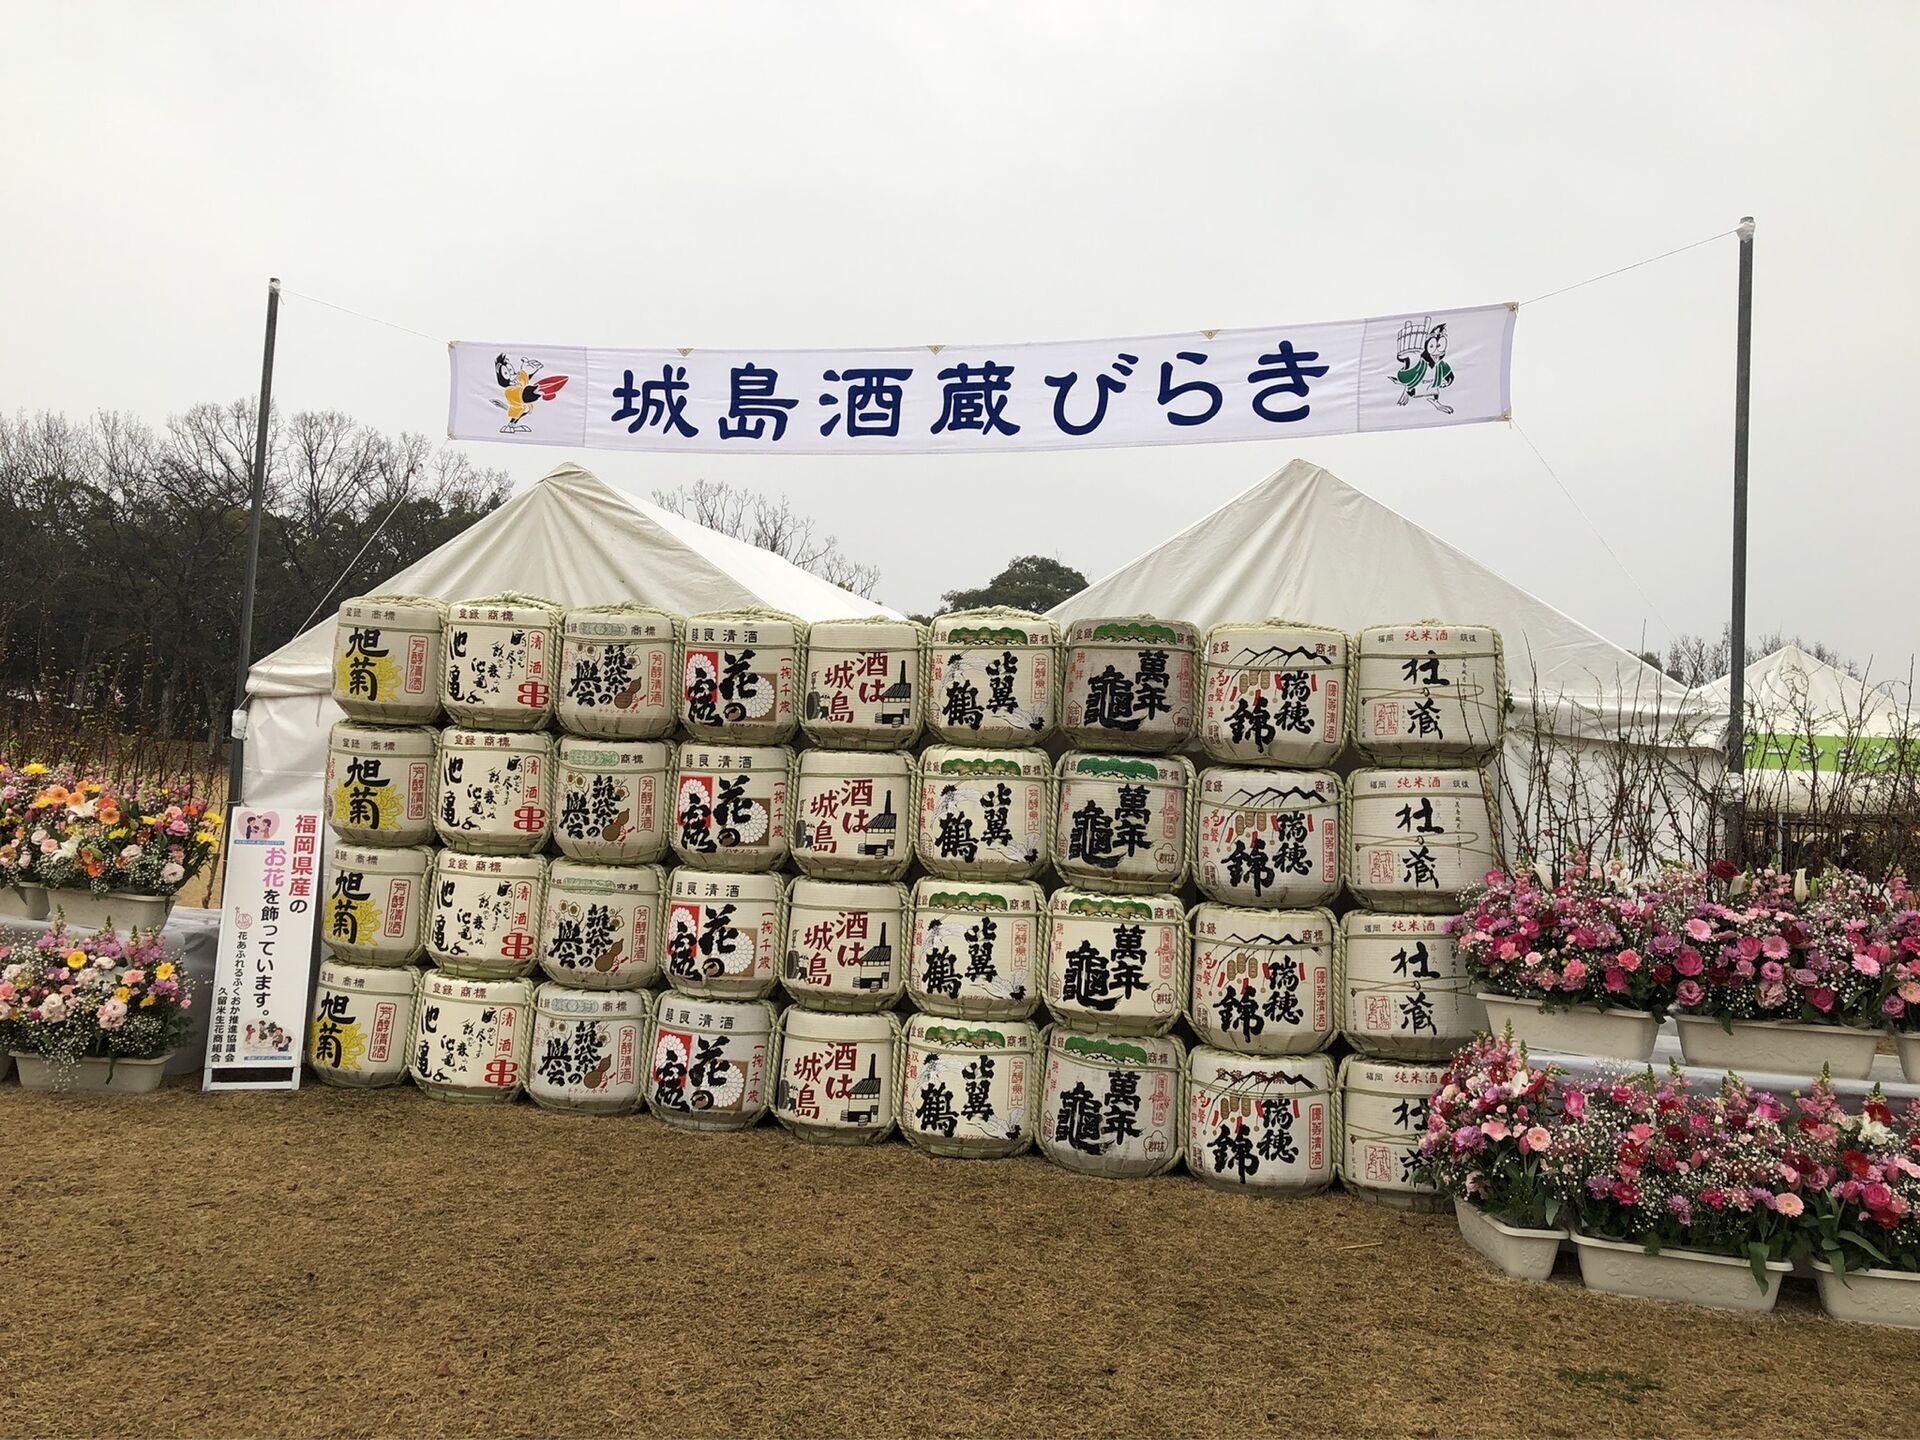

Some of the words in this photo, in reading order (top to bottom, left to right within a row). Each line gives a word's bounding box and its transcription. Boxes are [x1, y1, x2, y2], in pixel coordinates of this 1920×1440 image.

[610, 340, 1332, 442] 城島酒蔵びらき
[371, 610, 395, 621] 商標
[458, 608, 479, 620] 登録
[488, 610, 514, 621] 商標
[631, 625, 655, 636] 商標
[1029, 633, 1049, 644] 商標
[1176, 632, 1194, 645] 商標
[1378, 635, 1394, 643] 福岡
[1404, 630, 1448, 642] 純米酒
[346, 627, 389, 701] 旭菊
[529, 635, 542, 674] 清酒
[1212, 641, 1230, 654] 登録
[1315, 643, 1337, 656] 商標
[651, 654, 662, 703] 芳醇清酒
[719, 649, 759, 722] 花の
[824, 661, 855, 724] 城島
[856, 651, 888, 704] 酒は
[986, 651, 1019, 715] 比翼
[1134, 650, 1172, 720] 萬年
[942, 680, 984, 730] 鶴
[1224, 697, 1276, 753] 錦
[371, 741, 395, 751] 商標
[454, 734, 475, 745] 登録
[484, 736, 510, 747] 商標
[621, 754, 644, 764] 商標
[344, 757, 390, 830] 旭菊
[525, 760, 539, 799] 清酒
[1022, 764, 1042, 776] 商標
[1159, 769, 1179, 781] 商標
[1204, 780, 1222, 793] 登録
[1315, 780, 1335, 793] 商標
[1370, 781, 1387, 789] 福岡
[1397, 776, 1441, 788] 純米酒
[640, 779, 653, 829] 芳醇清酒
[713, 775, 753, 847] 花の
[810, 790, 839, 854] 城島
[841, 779, 873, 834] 酒は
[980, 783, 1013, 847] 比翼
[1115, 784, 1153, 856] 萬年
[356, 855, 378, 865] 商標
[936, 811, 978, 863] 鶴
[288, 814, 317, 914] 福岡県産の
[448, 858, 468, 870] 登録
[476, 860, 501, 872] 商標
[616, 883, 639, 891] 商標
[1221, 840, 1274, 897] 錦
[332, 870, 371, 944] 旭菊
[514, 886, 529, 925] 清酒
[1009, 899, 1031, 910] 商標
[1154, 908, 1175, 920] 商標
[1364, 924, 1382, 933] 福岡
[1392, 920, 1436, 932] 純米酒
[253, 848, 287, 1017] お花を飾っています。
[633, 909, 647, 960] 芳醇清酒
[698, 903, 738, 977] 花の
[804, 921, 834, 987] 城島
[836, 911, 868, 968] 酒は
[964, 916, 998, 983] 比翼
[1199, 921, 1217, 935] 登録
[1302, 929, 1324, 942] 商標
[343, 976, 365, 987] 商標
[922, 946, 963, 1000] 鶴
[1109, 923, 1151, 999] 萬年
[224, 932, 248, 1062] 花あふれるふくおか推進協議会
[432, 983, 452, 995] 登録
[460, 987, 486, 999] 商標
[602, 1001, 627, 1012] 商標
[1213, 985, 1265, 1043] 錦
[210, 987, 228, 1062] 久留米生花商組合
[317, 991, 356, 1068] 旭菊
[498, 1012, 514, 1052] 清酒
[1007, 1035, 1027, 1047] 商標
[619, 1029, 634, 1080] 芳醇清酒
[689, 1035, 730, 1110] 花の
[824, 1042, 857, 1100] 酒は
[1148, 1052, 1168, 1064] 商標
[1215, 1068, 1244, 1082] 登録
[1254, 1071, 1285, 1085] 商標
[1366, 1072, 1384, 1081] 福岡
[1394, 1071, 1438, 1085] 純米酒
[794, 1052, 823, 1120] 城島
[916, 1082, 958, 1138] 鶴
[961, 1055, 995, 1122] 比翼
[1103, 1068, 1143, 1145] 萬年
[1207, 1124, 1260, 1184] 錦
